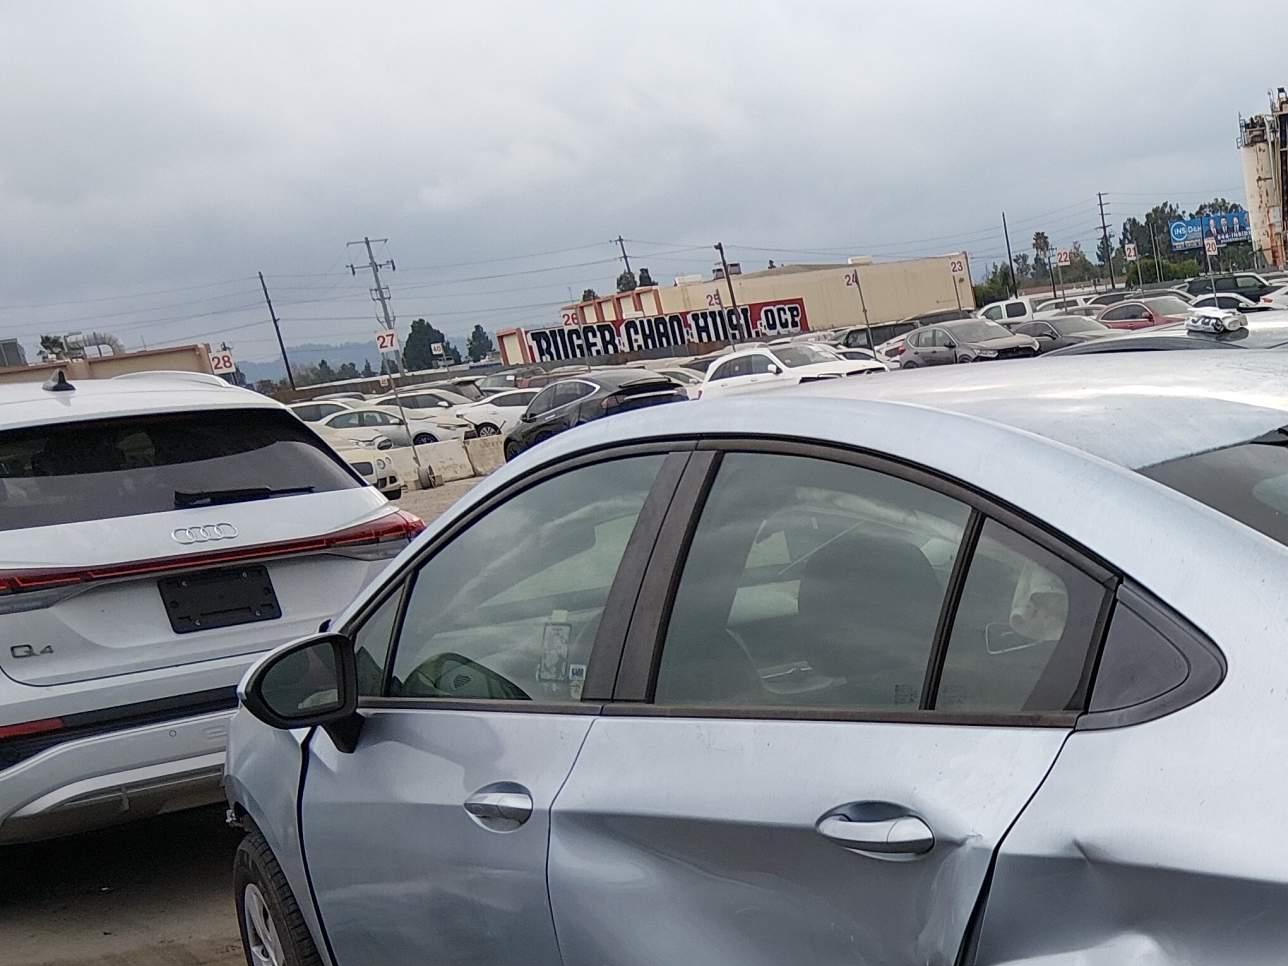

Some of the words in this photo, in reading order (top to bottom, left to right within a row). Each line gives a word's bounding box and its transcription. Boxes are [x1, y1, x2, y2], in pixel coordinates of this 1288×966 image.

[1127, 247, 1137, 257] 21
[1206, 242, 1217, 253] 20
[1058, 250, 1068, 262] 22
[951, 260, 963, 272] 23
[844, 272, 858, 287] 24
[706, 294, 721, 306] 25
[562, 313, 578, 326] 26
[762, 304, 801, 334] OCP
[376, 333, 395, 349] 27
[211, 355, 233, 370] 28
[10, 644, 54, 658] Q4
